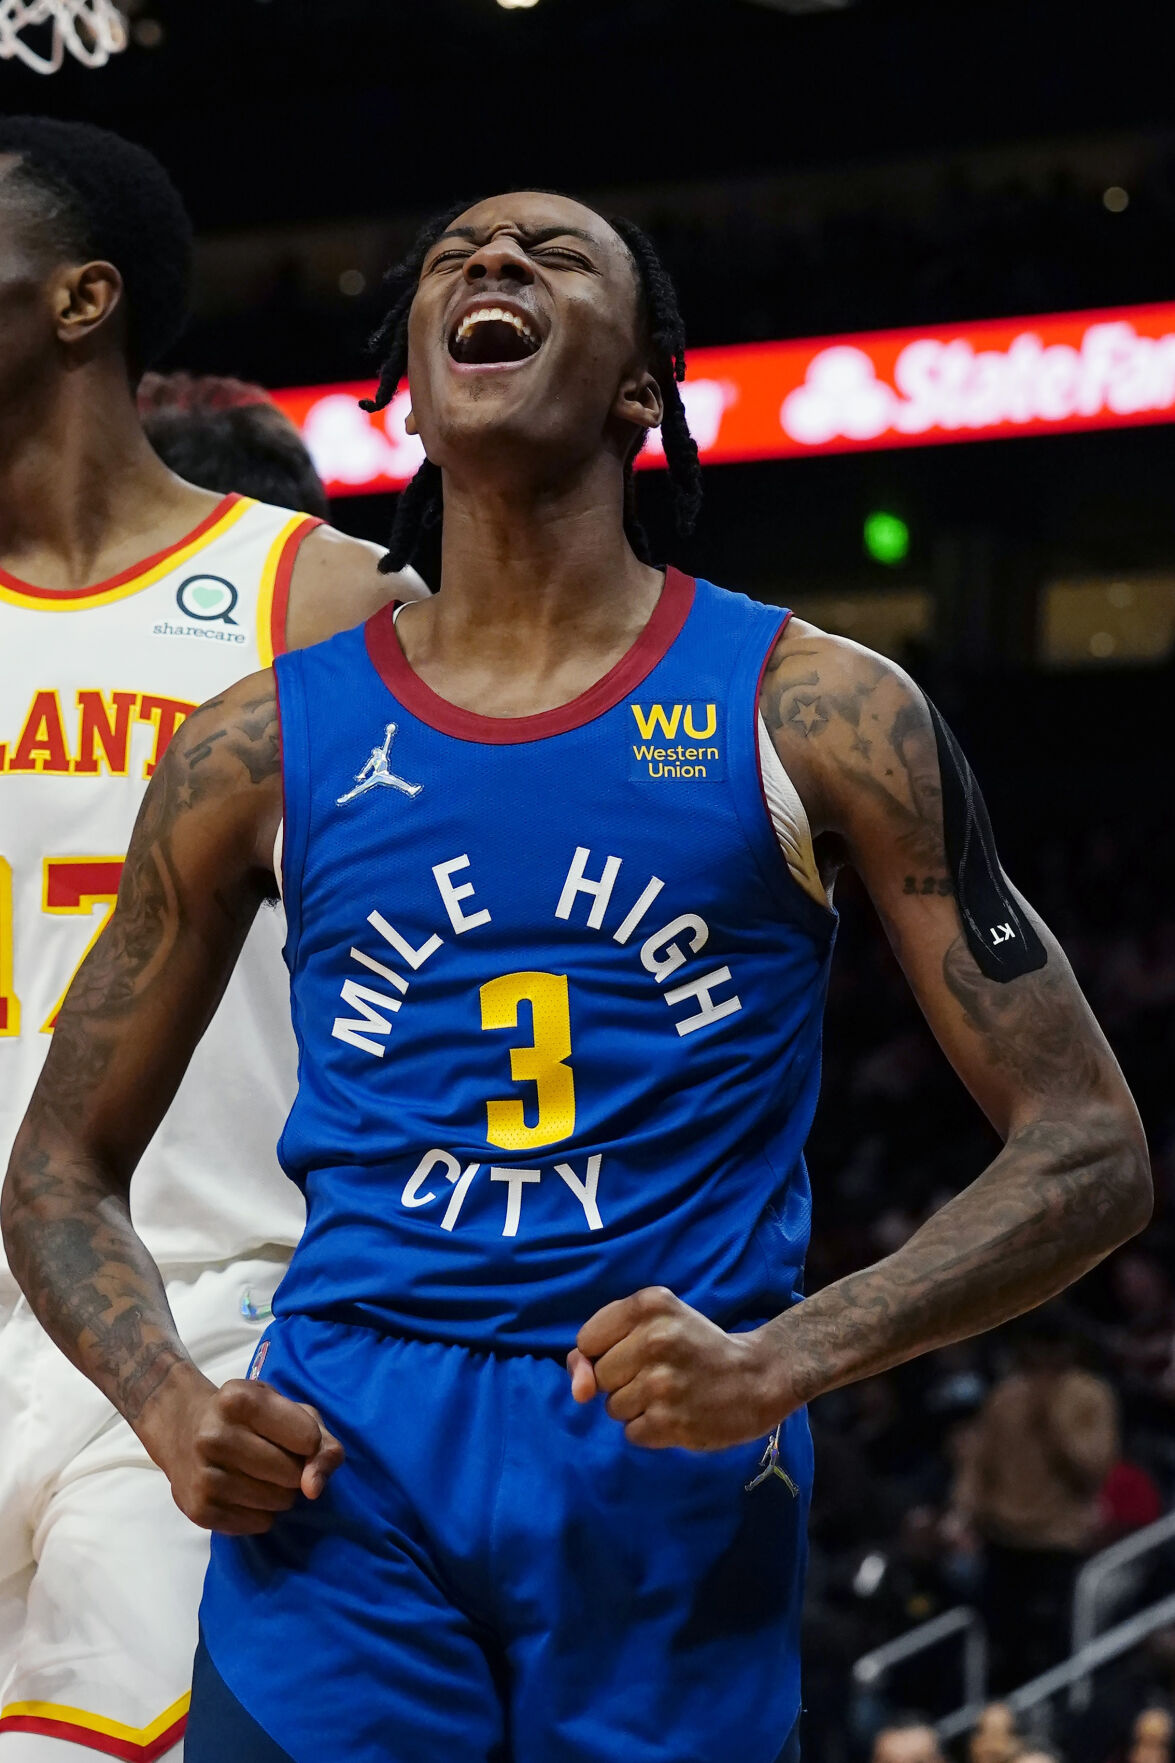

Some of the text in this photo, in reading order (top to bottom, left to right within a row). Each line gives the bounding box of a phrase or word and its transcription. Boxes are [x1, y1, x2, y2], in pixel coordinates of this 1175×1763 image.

[153, 622, 245, 644] sharecare
[630, 704, 717, 740] WU
[632, 745, 719, 761] Western
[648, 761, 707, 778] Union
[990, 923, 1016, 946] KT
[331, 846, 743, 1058] MILE HIGH
[479, 971, 576, 1151] 3
[400, 1148, 604, 1237] CITY
